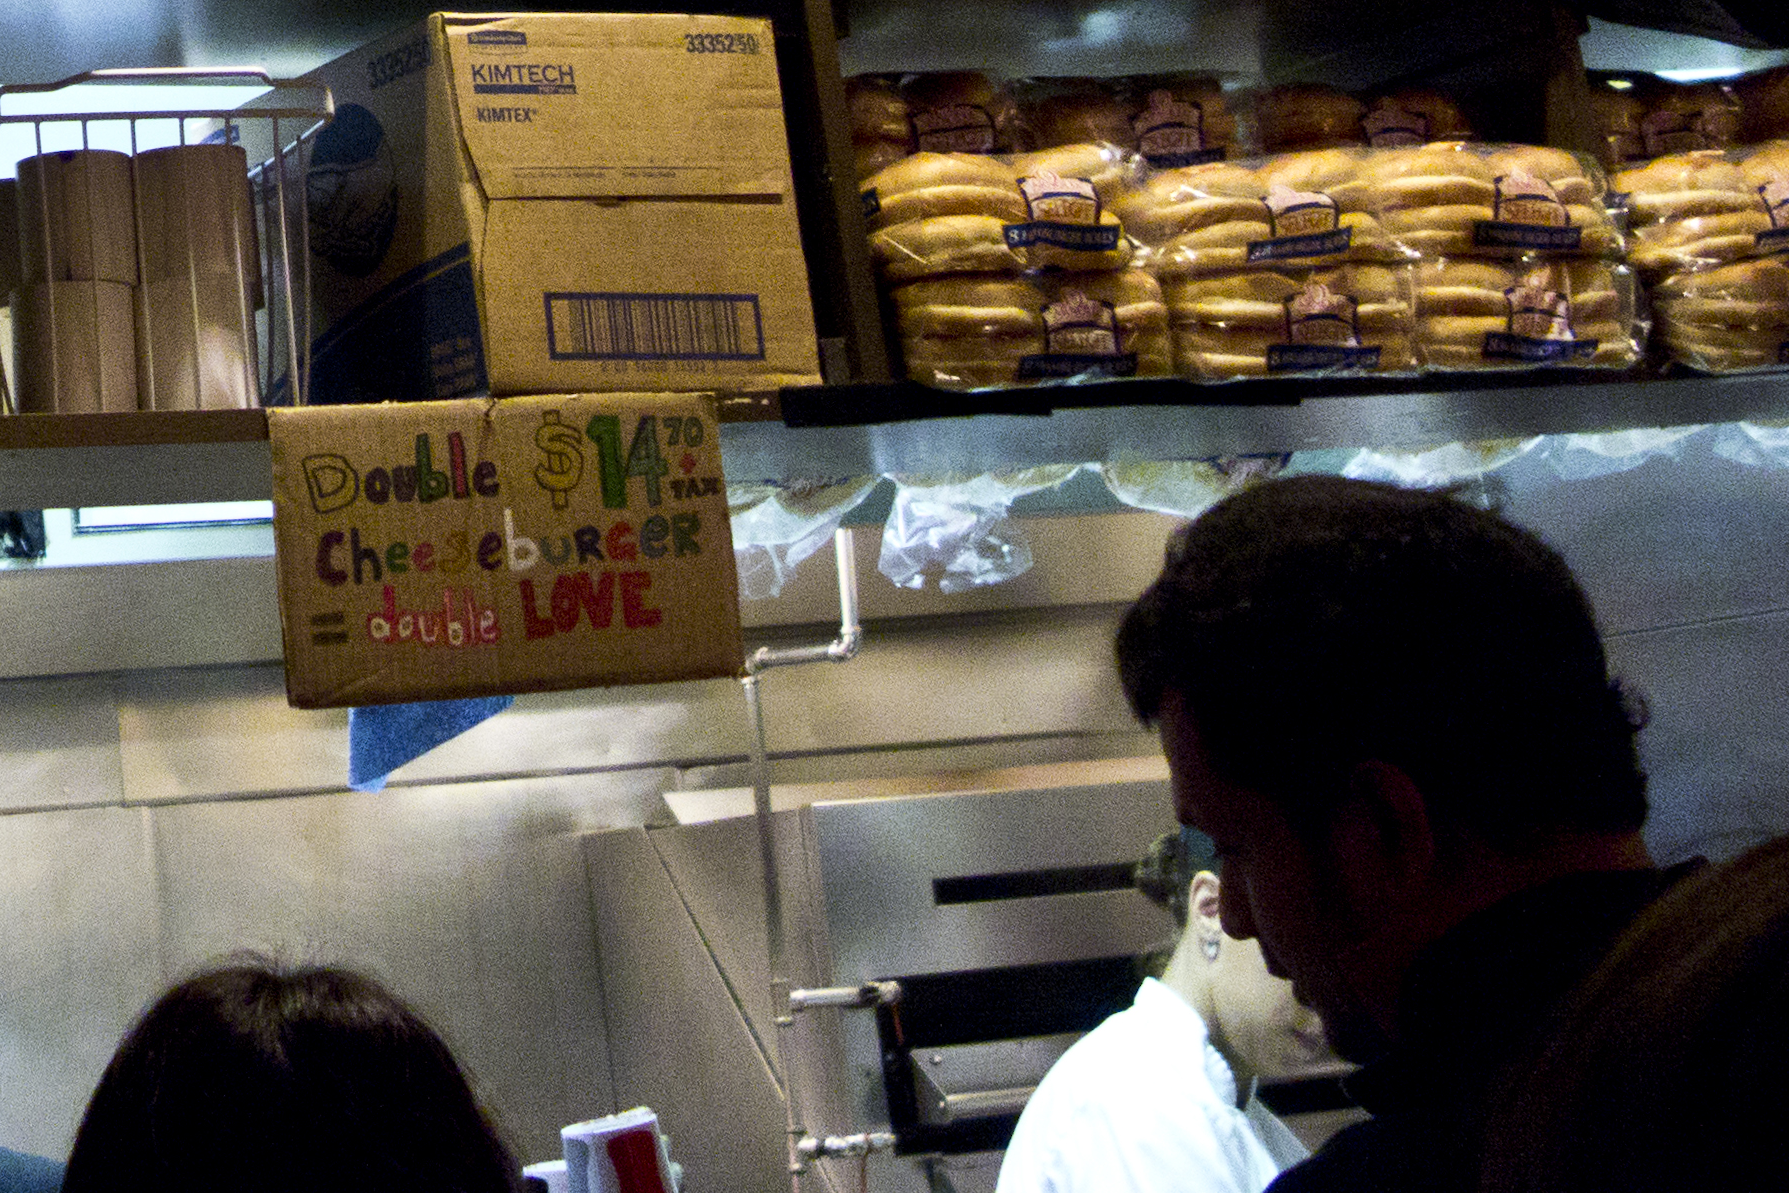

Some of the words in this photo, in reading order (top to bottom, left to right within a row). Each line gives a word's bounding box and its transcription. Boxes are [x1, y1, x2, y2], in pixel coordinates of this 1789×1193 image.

[470, 62, 576, 85] KIMTECH
[301, 431, 501, 514] Double
[366, 584, 501, 648] double
[520, 570, 663, 641] LOVE
